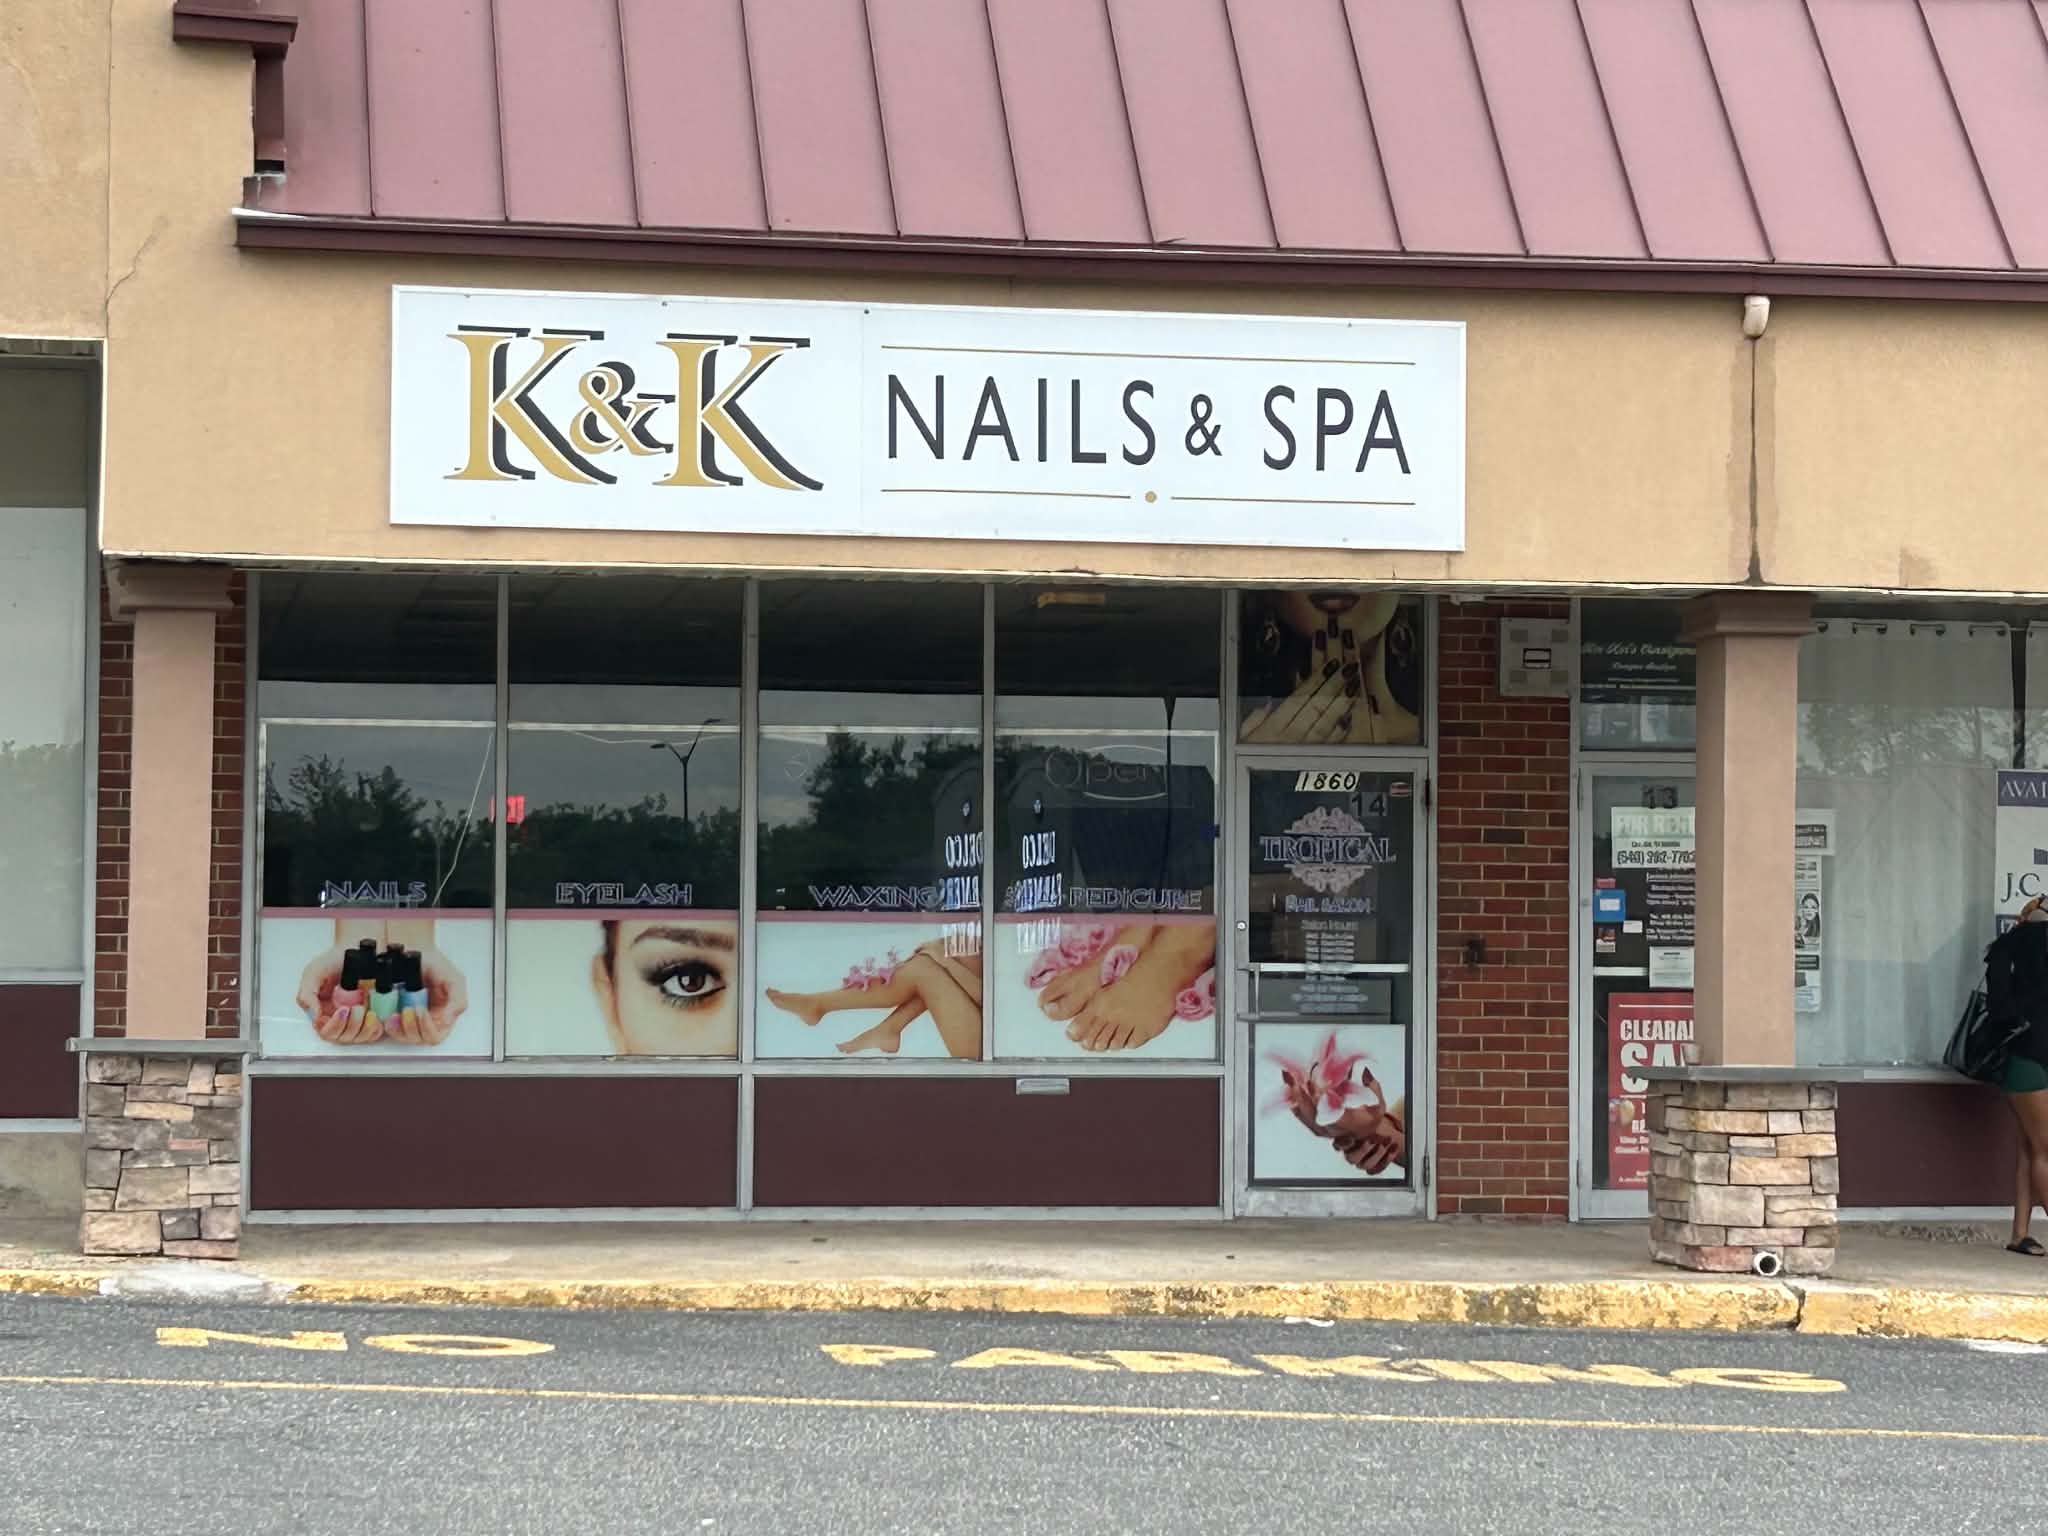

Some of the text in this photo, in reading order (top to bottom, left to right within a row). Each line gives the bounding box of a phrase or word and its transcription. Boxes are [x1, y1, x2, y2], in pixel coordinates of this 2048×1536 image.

[443, 324, 823, 491] K&K
[888, 374, 1411, 474] NAILS & SPA
[1300, 771, 1357, 791] 1860
[1351, 793, 1387, 817] 14
[1260, 835, 1397, 862] TROPICAL
[325, 880, 428, 903] NAILS
[555, 882, 693, 905] EYELASH
[808, 884, 940, 908] WAXING
[1070, 887, 1202, 911] PEDICURE
[155, 1327, 555, 1356] NO
[820, 1343, 1847, 1393] PARKING
